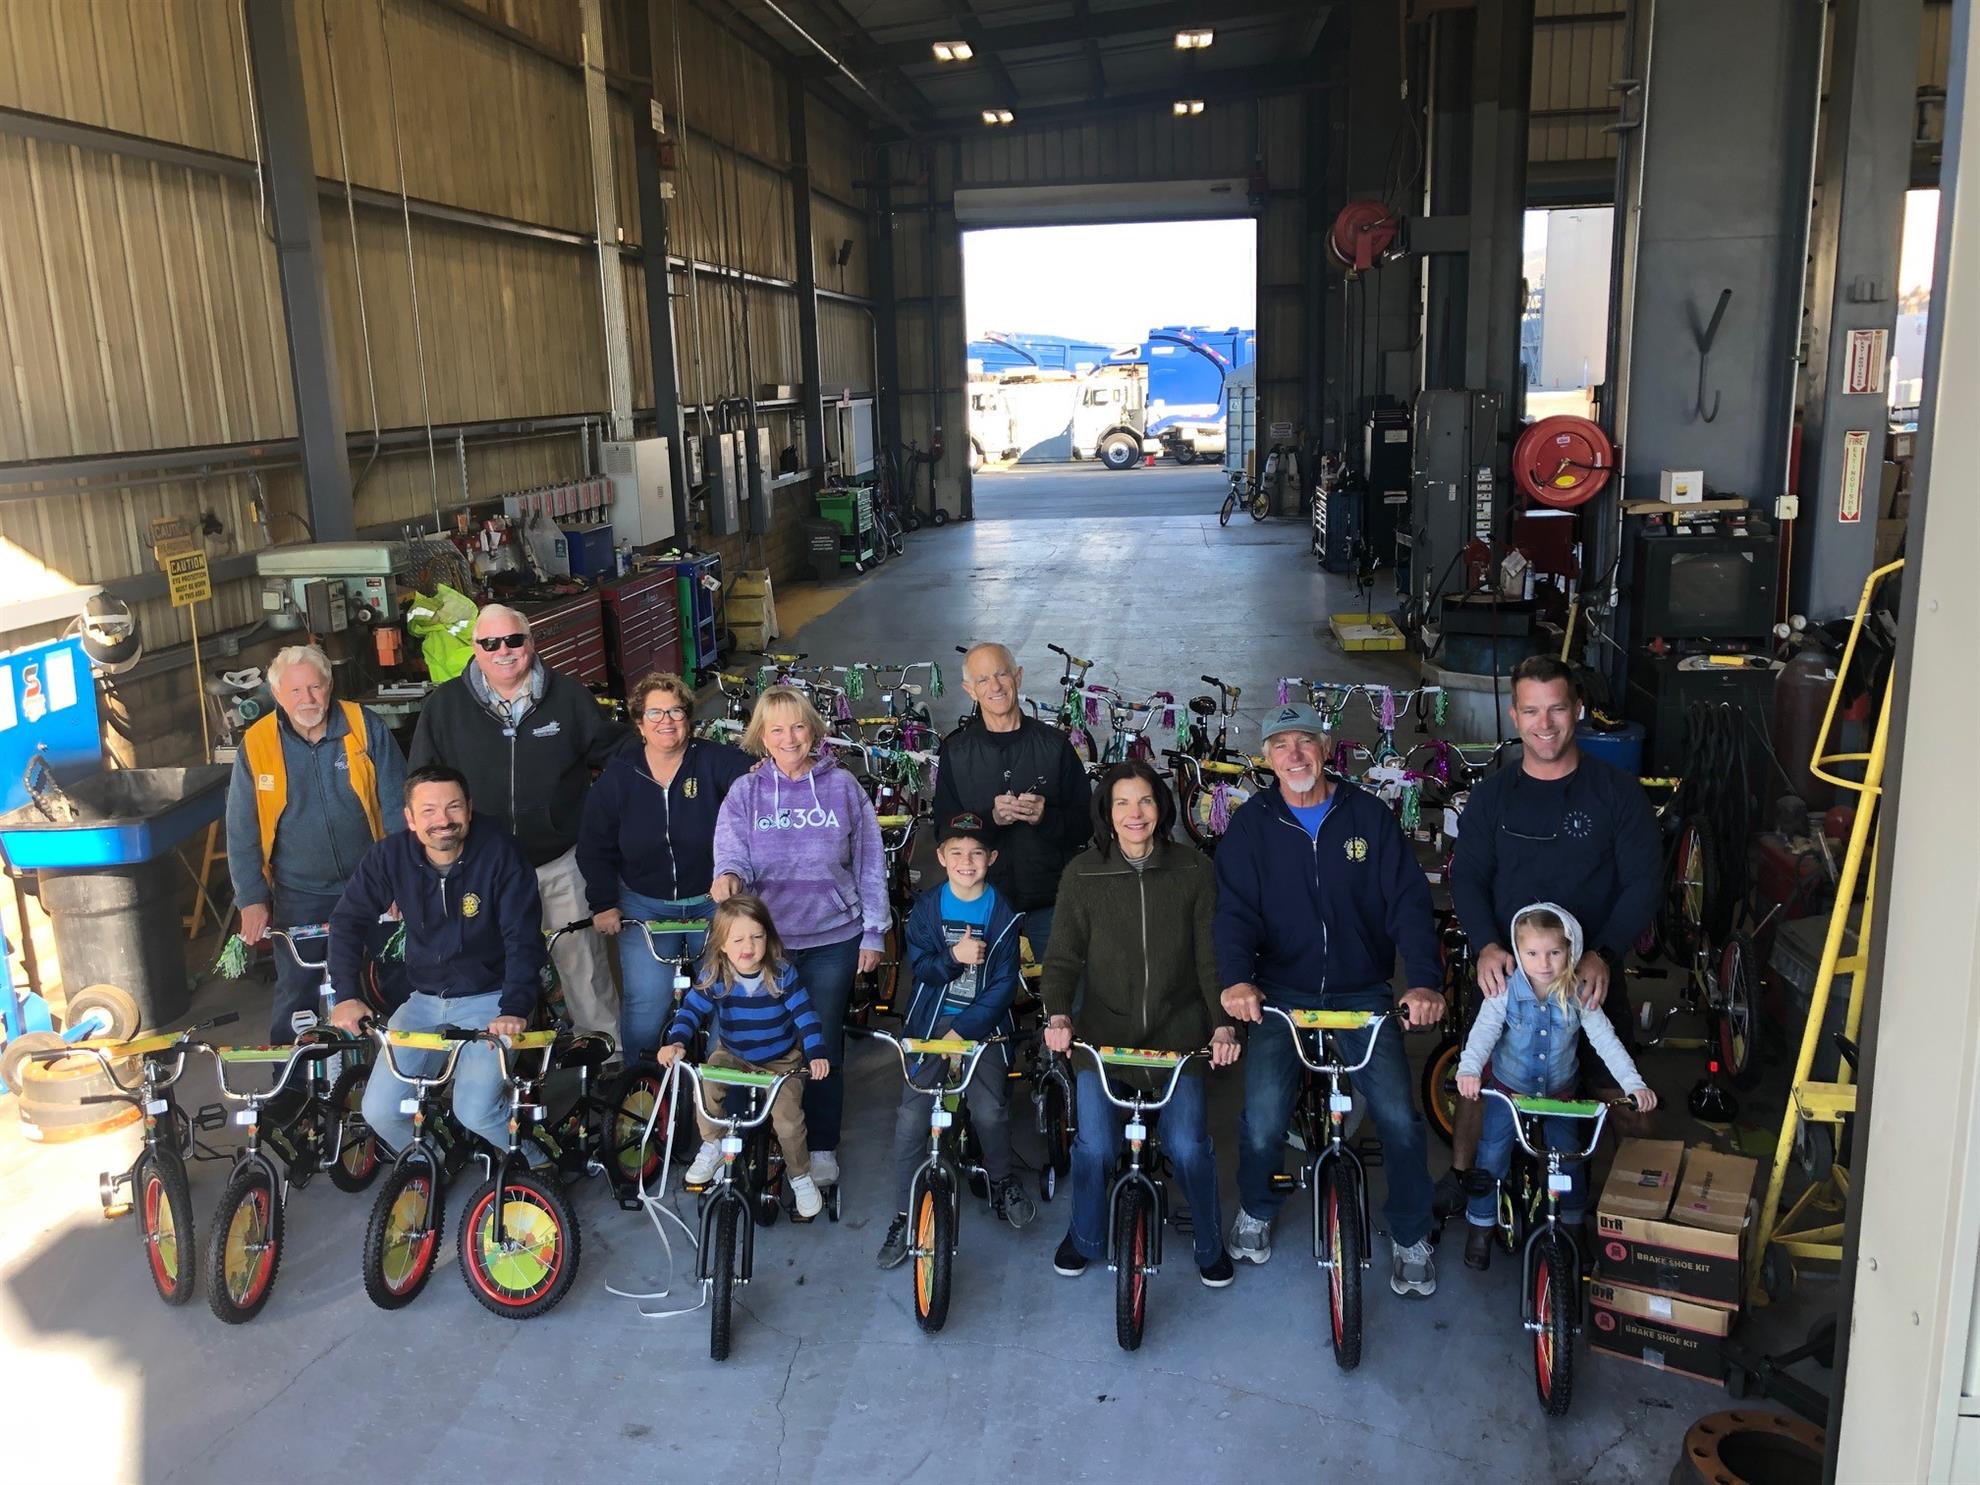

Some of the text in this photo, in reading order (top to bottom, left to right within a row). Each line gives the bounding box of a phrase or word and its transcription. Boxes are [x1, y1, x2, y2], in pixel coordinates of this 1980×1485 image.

[1848, 437, 1864, 446] FIRE
[1847, 446, 1857, 516] EXTINGUISHER
[170, 556, 206, 574] CAUTION
[793, 808, 840, 829] 30A
[1636, 1252, 1711, 1273] BRAKE SHOE KIT
[1625, 1324, 1699, 1349] BRAKE SHOE KIT
